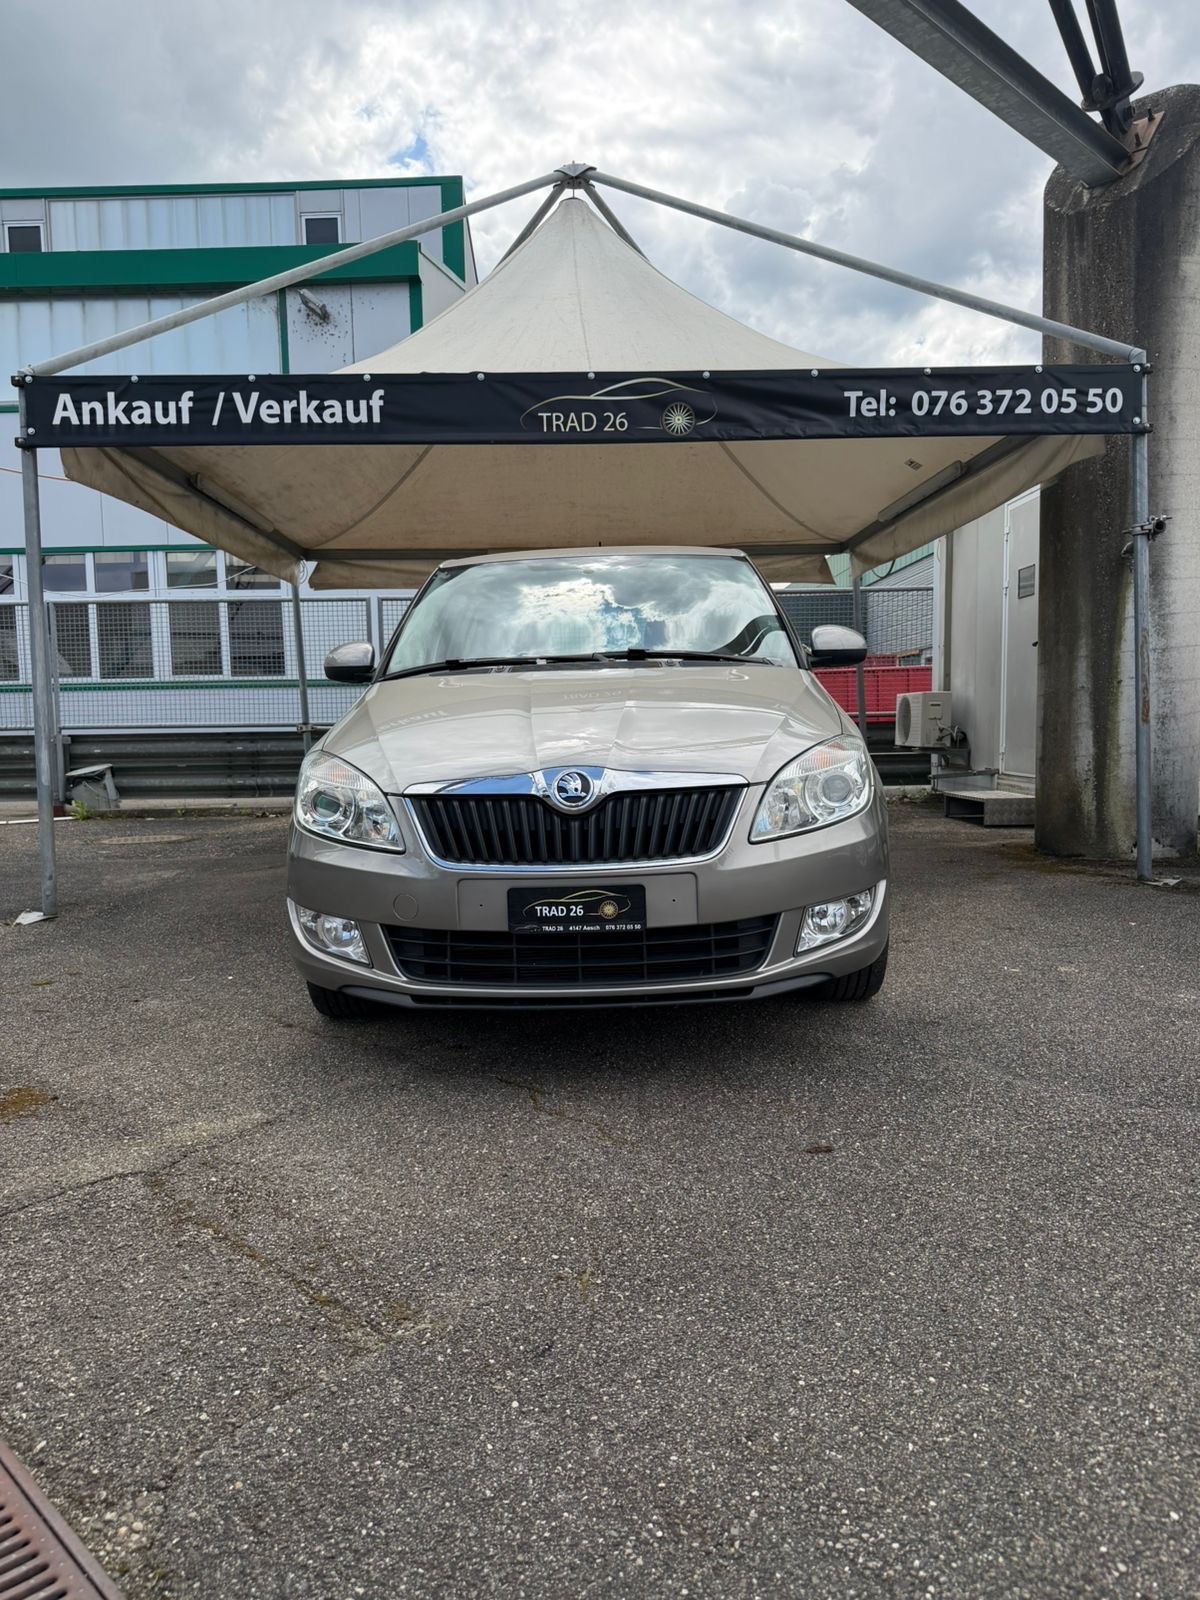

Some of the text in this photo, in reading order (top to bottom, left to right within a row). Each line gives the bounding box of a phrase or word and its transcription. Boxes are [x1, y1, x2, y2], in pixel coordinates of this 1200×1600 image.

[52, 391, 194, 425] Ankauf
[843, 387, 1124, 418] Tel: 076 372 05 50
[538, 411, 629, 433] TRAD 26
[535, 904, 584, 917] TRAD 26
